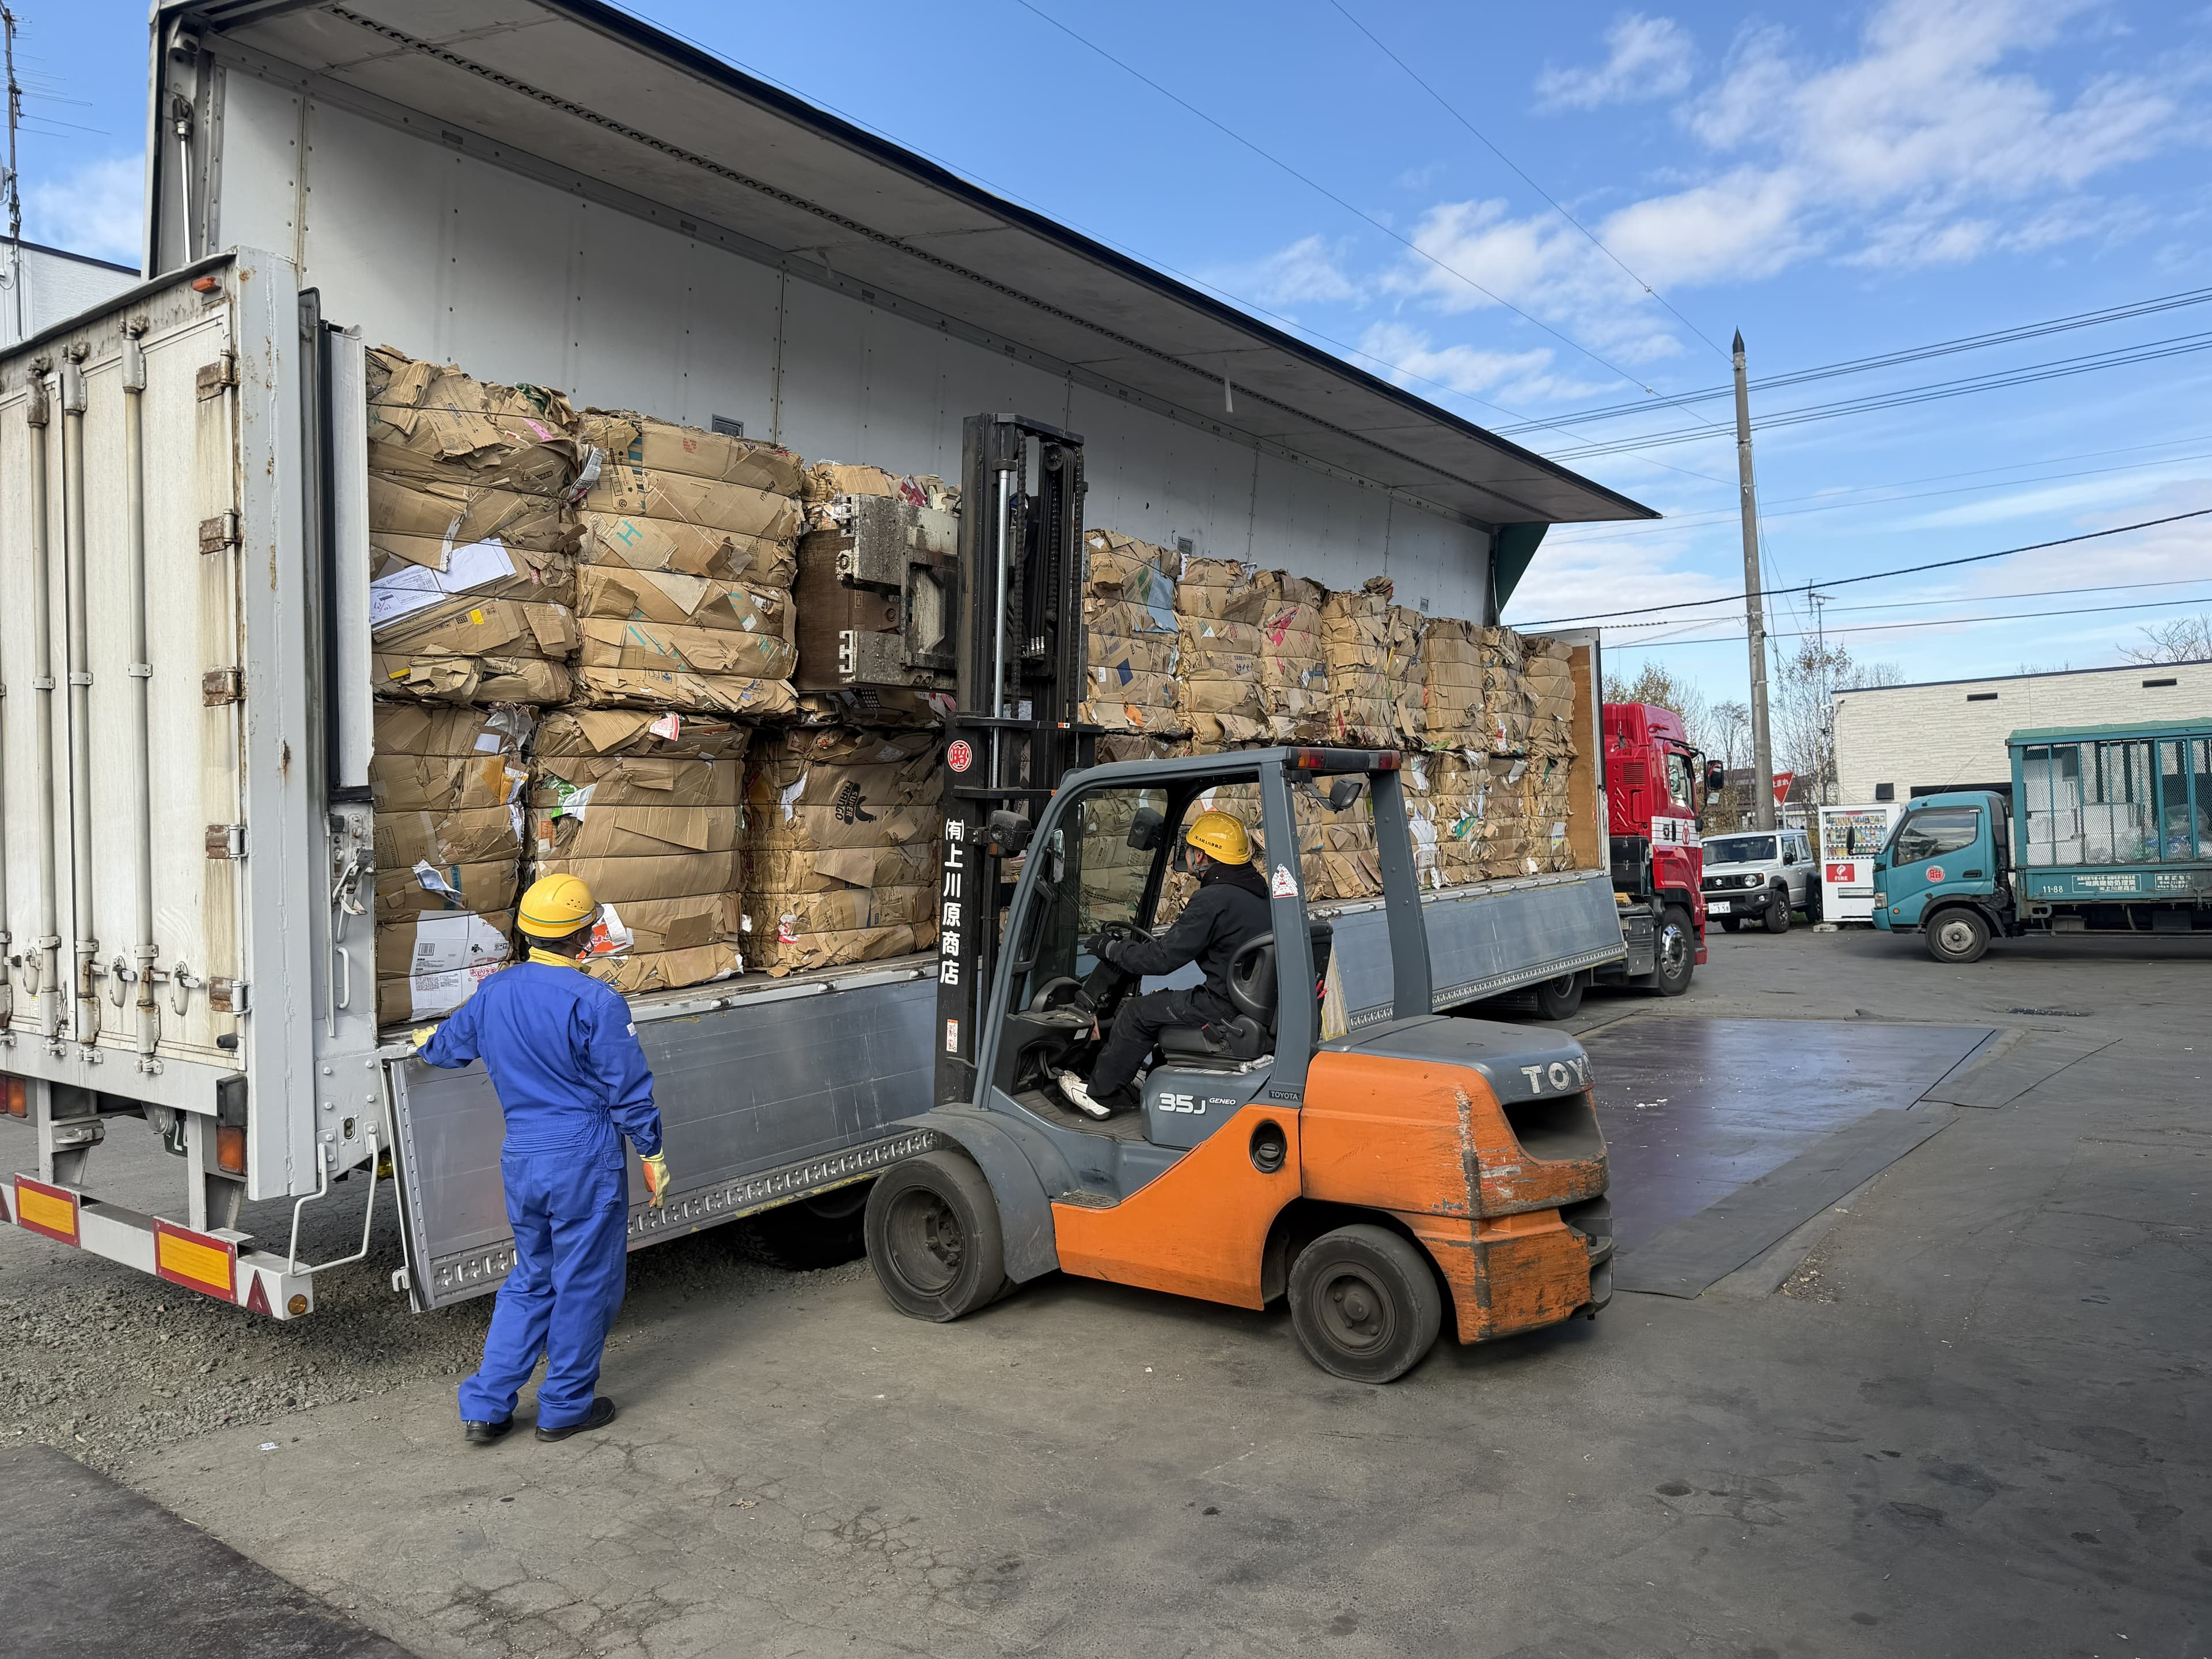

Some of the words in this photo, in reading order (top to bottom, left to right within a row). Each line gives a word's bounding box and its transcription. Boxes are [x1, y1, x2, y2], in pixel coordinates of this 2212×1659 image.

[835, 780, 854, 821] FRANGO
[846, 791, 858, 817] SUPER
[1158, 1093, 1206, 1115] 35J
[1271, 1090, 1299, 1100] TOYOTA
